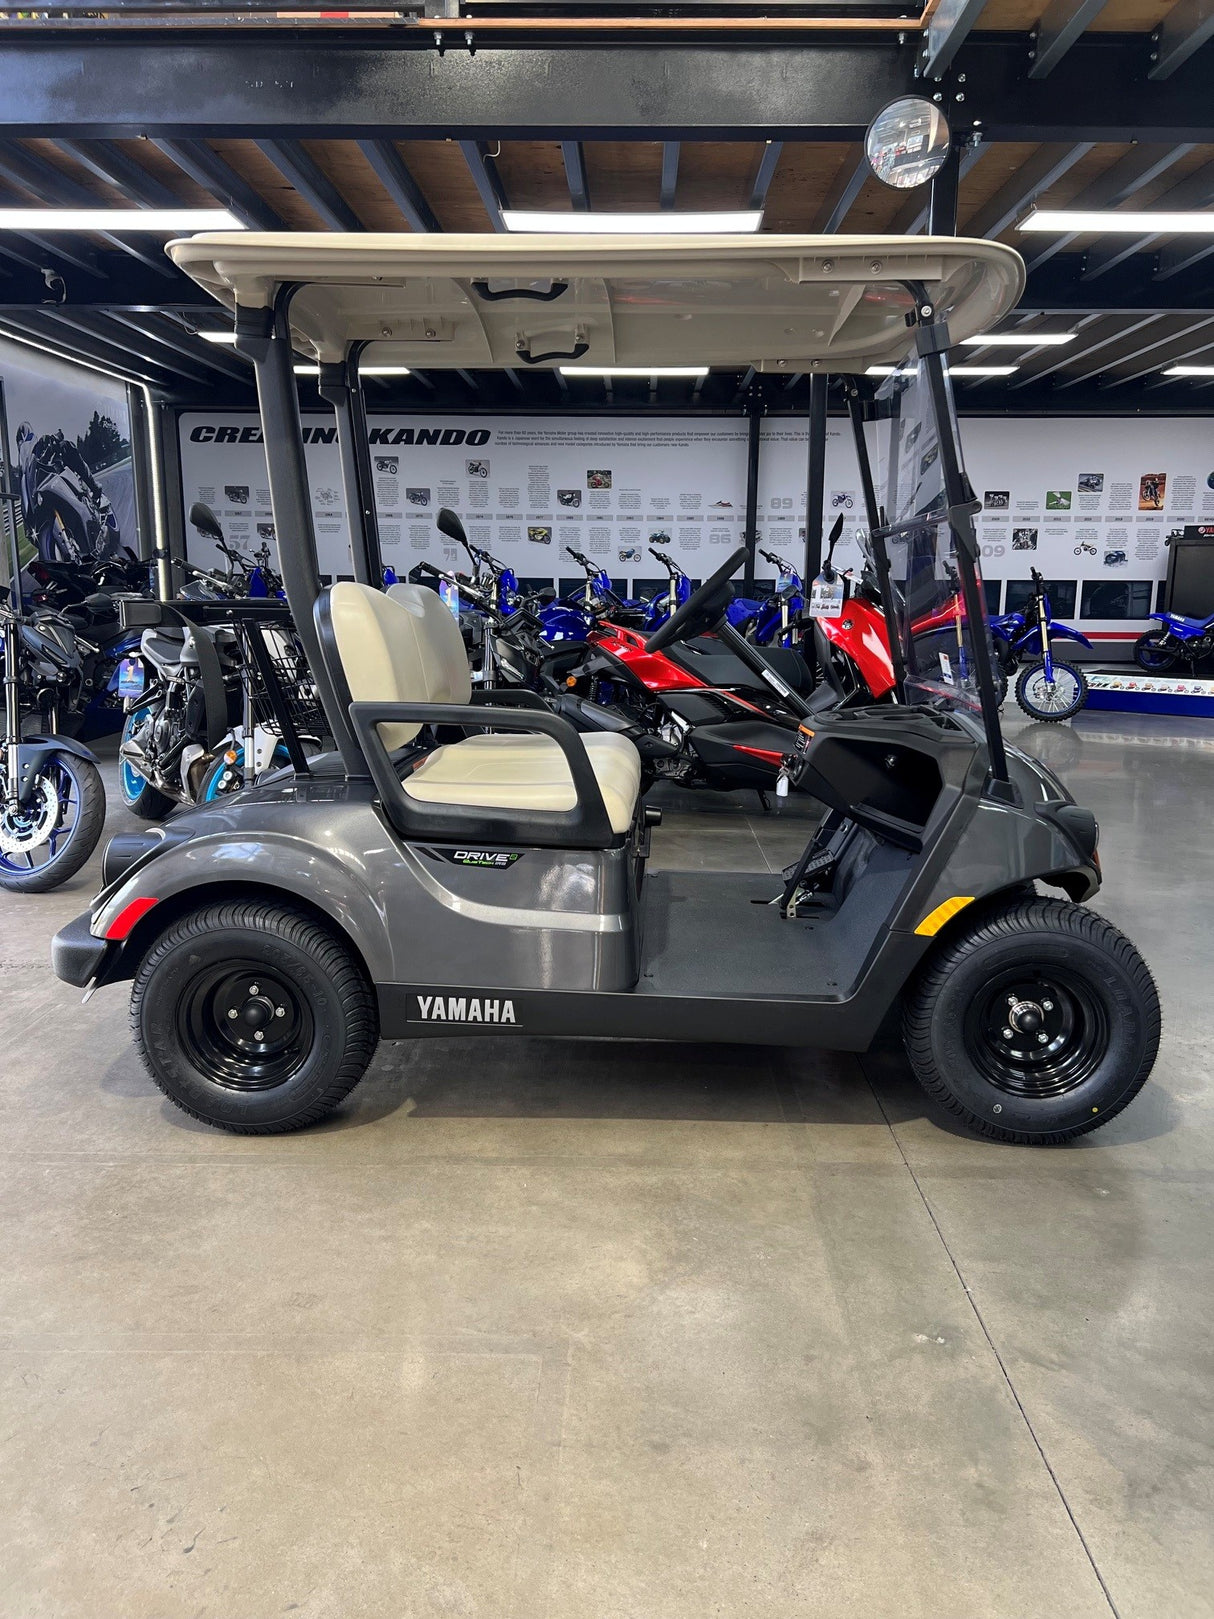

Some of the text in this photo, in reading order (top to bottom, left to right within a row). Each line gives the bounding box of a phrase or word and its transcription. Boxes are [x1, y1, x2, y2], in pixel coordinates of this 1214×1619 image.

[190, 426, 491, 446] CREIN KANDO
[230, 535, 250, 550] 57
[982, 545, 1005, 557] 09
[417, 996, 516, 1023] YAMAHA
